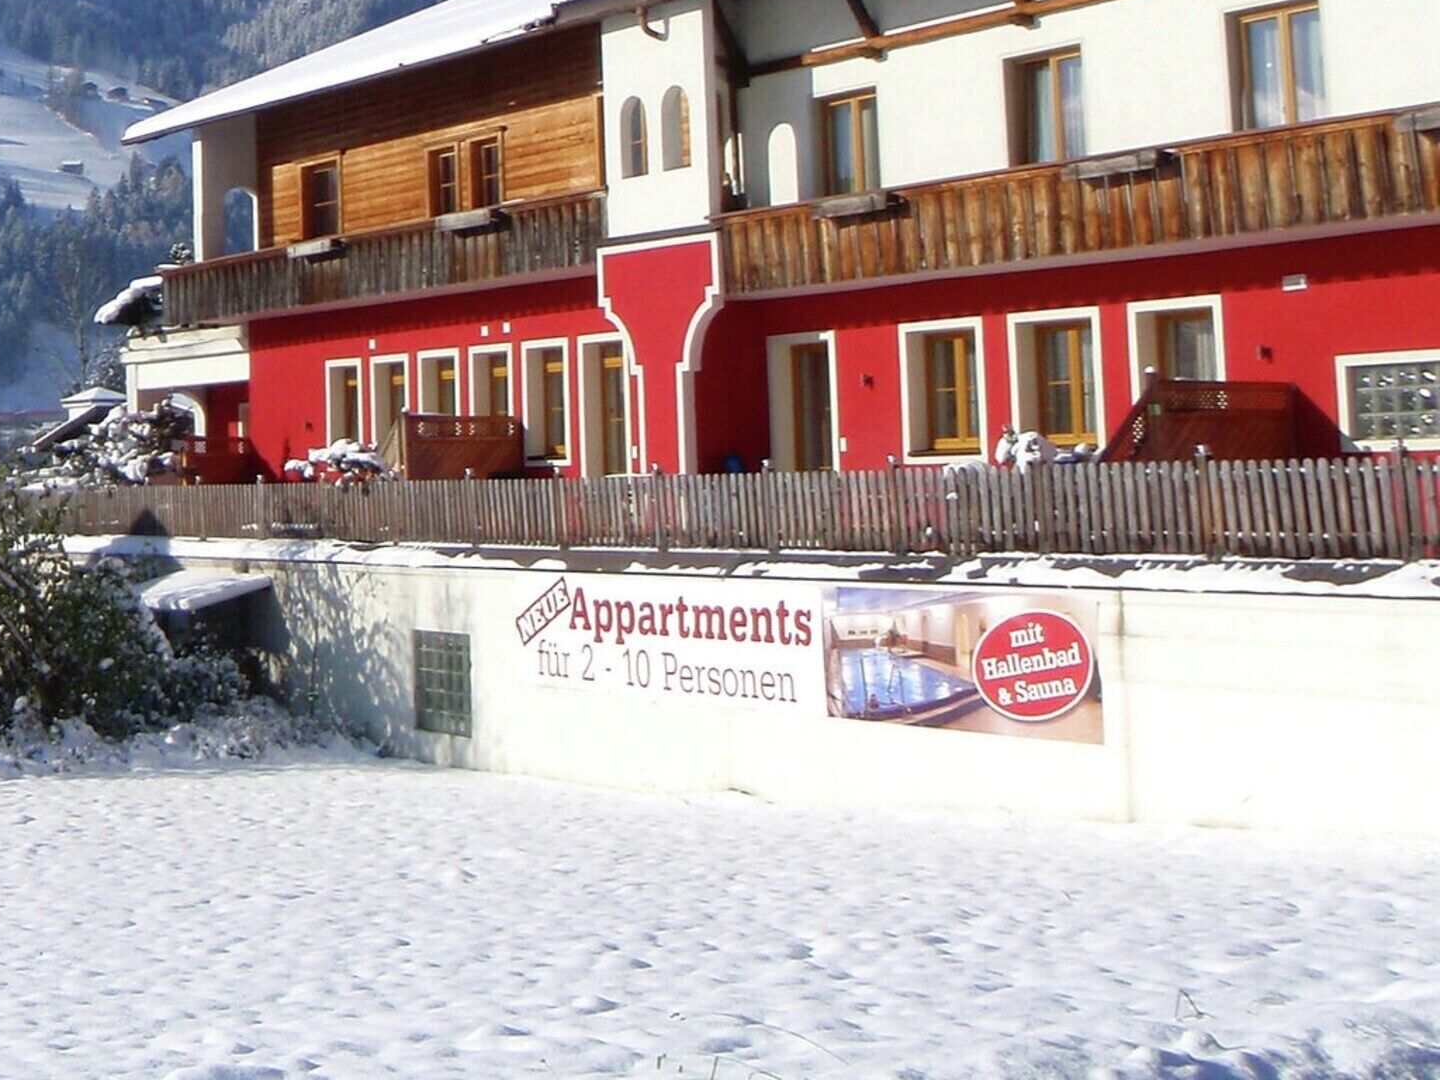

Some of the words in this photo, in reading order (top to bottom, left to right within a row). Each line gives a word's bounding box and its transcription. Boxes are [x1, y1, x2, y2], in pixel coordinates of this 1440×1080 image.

[517, 578, 570, 643] NEUE
[569, 587, 812, 646] Appartments
[1009, 622, 1045, 648] mit
[538, 639, 570, 678] für
[581, 644, 595, 681] 2
[623, 648, 651, 688] 10
[661, 652, 797, 703] Personen
[981, 642, 1082, 681] Hallenbad
[998, 687, 1013, 706] &
[1014, 677, 1078, 703] Sauna
